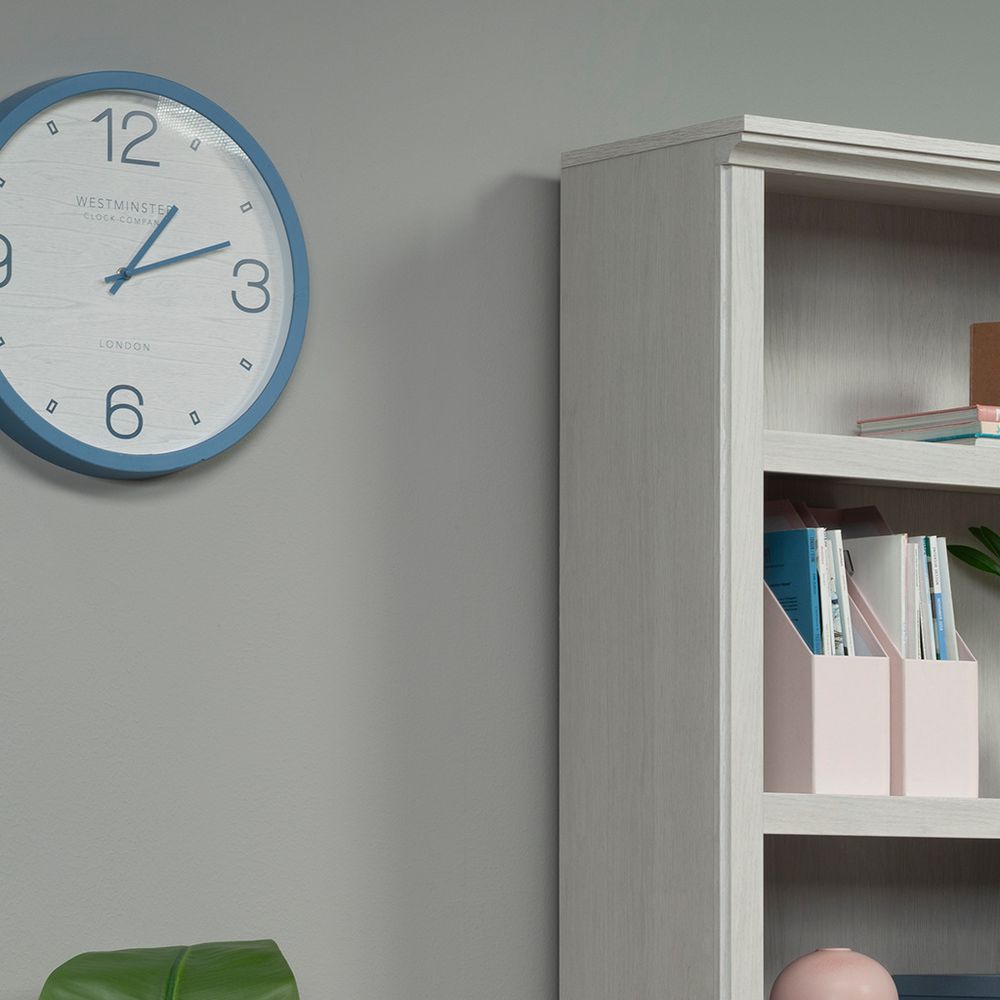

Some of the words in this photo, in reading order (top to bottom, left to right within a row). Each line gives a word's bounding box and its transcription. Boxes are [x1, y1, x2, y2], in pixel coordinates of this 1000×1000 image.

[91, 107, 161, 167] 12
[83, 212, 115, 221] CLOCK
[119, 215, 161, 226] COMPAN
[231, 258, 271, 314] 3
[99, 339, 151, 352] LONDON
[105, 384, 144, 440] 6
